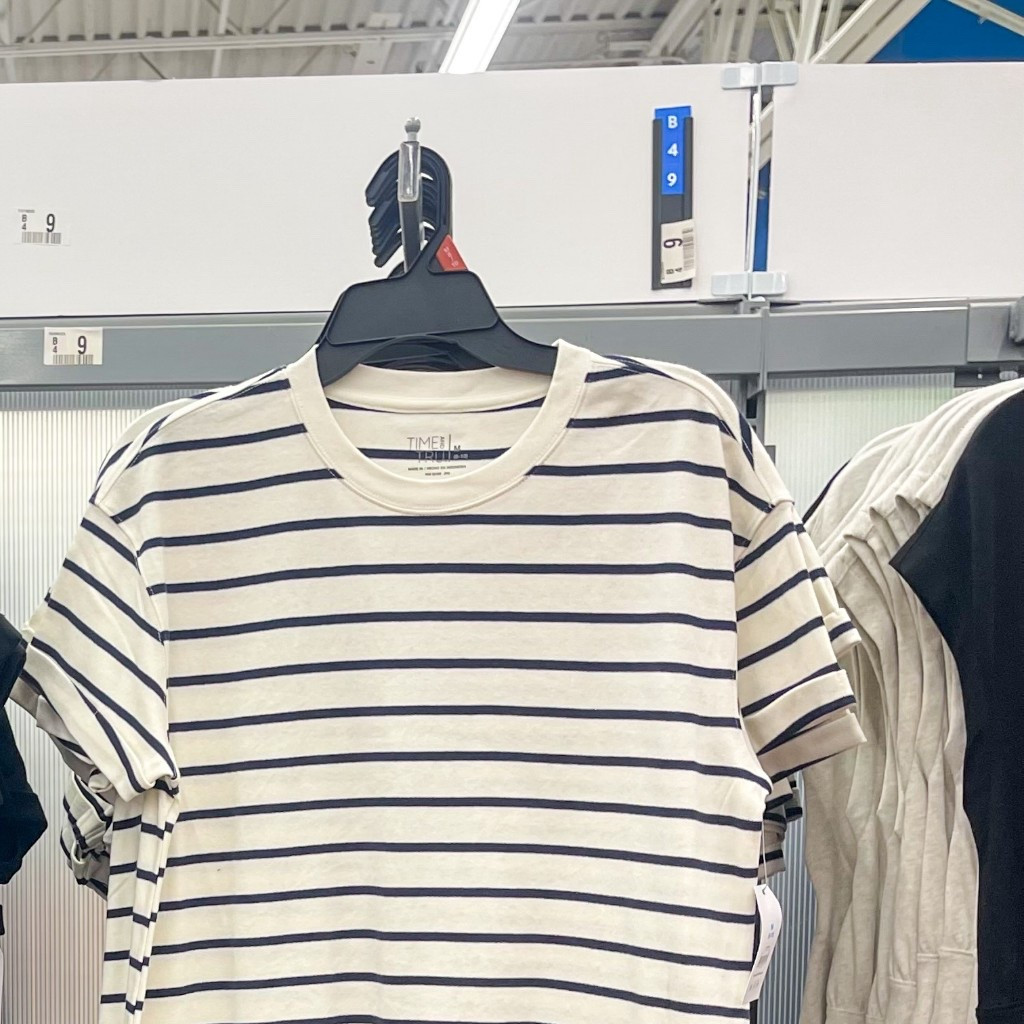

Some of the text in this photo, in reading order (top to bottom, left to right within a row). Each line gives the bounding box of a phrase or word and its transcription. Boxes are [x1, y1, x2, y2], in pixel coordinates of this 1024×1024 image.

[667, 115, 678, 129] B
[666, 143, 679, 157] 4
[666, 172, 678, 187] 9
[46, 213, 56, 233] 9
[663, 238, 683, 249] 9
[77, 335, 87, 355] 9
[407, 436, 439, 450] TIME
